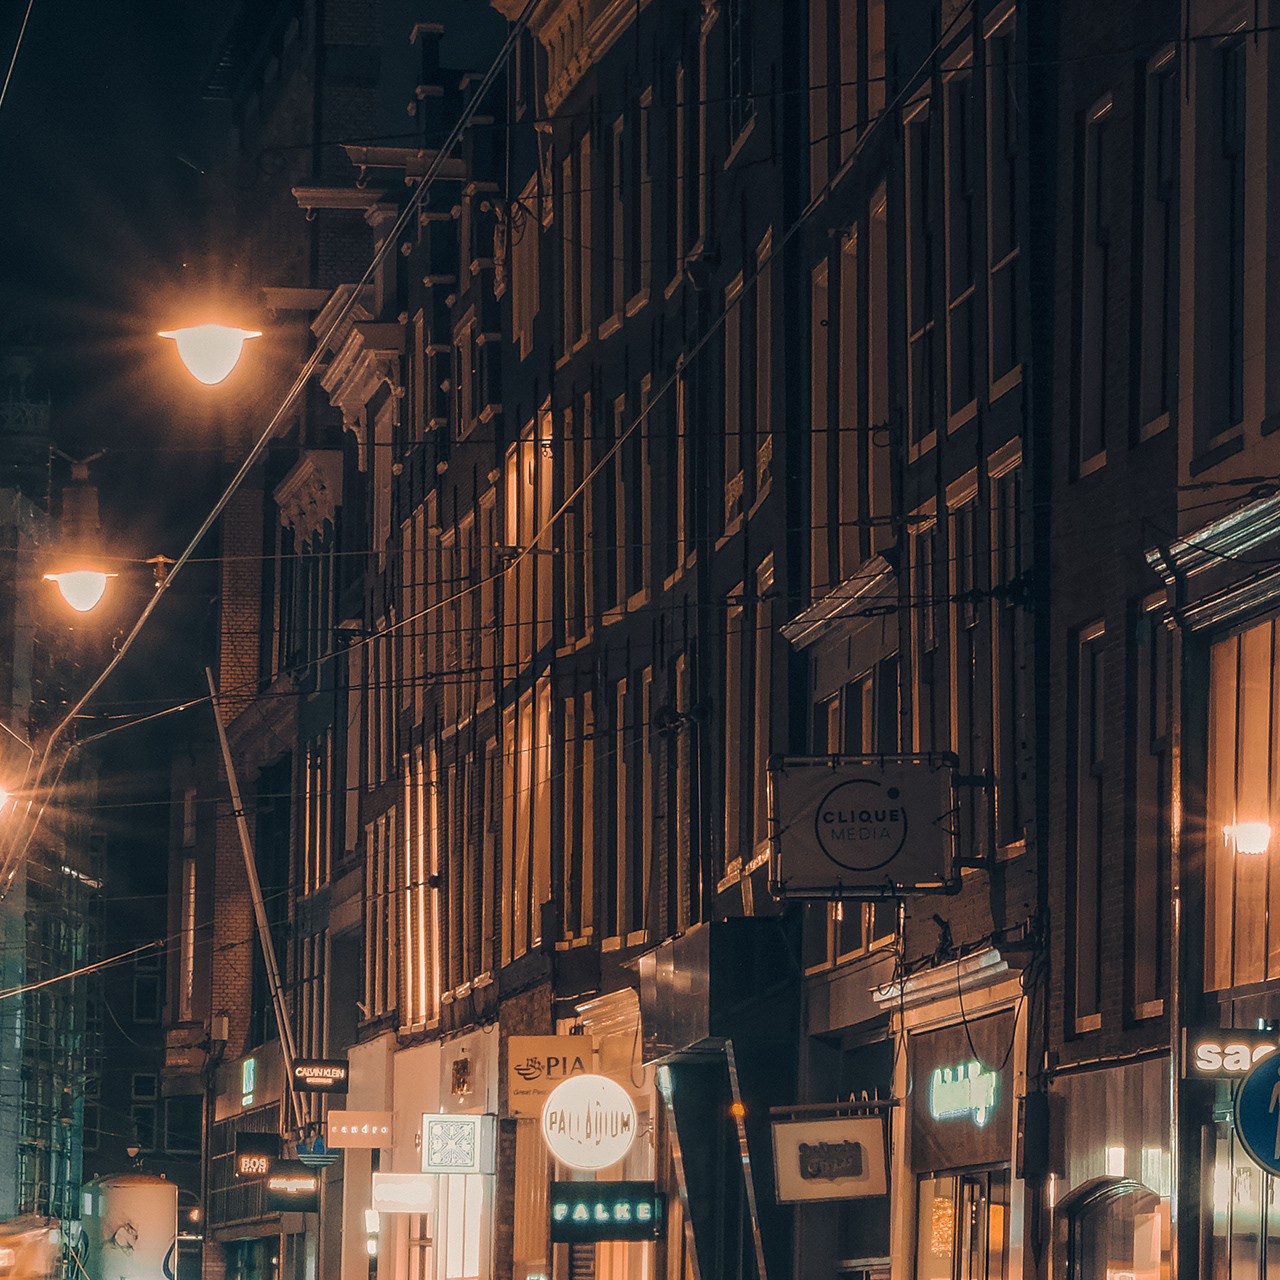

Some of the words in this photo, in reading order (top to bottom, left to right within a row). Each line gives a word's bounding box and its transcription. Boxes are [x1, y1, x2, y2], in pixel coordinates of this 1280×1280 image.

[822, 809, 900, 824] CLIQUE
[830, 827, 892, 841] MEDIA
[295, 1067, 323, 1077] CALVIN
[323, 1068, 345, 1078] KLEIN
[546, 1056, 586, 1076] PIA
[549, 1100, 631, 1146] PALLADIUM
[553, 1202, 652, 1221] FALKE
